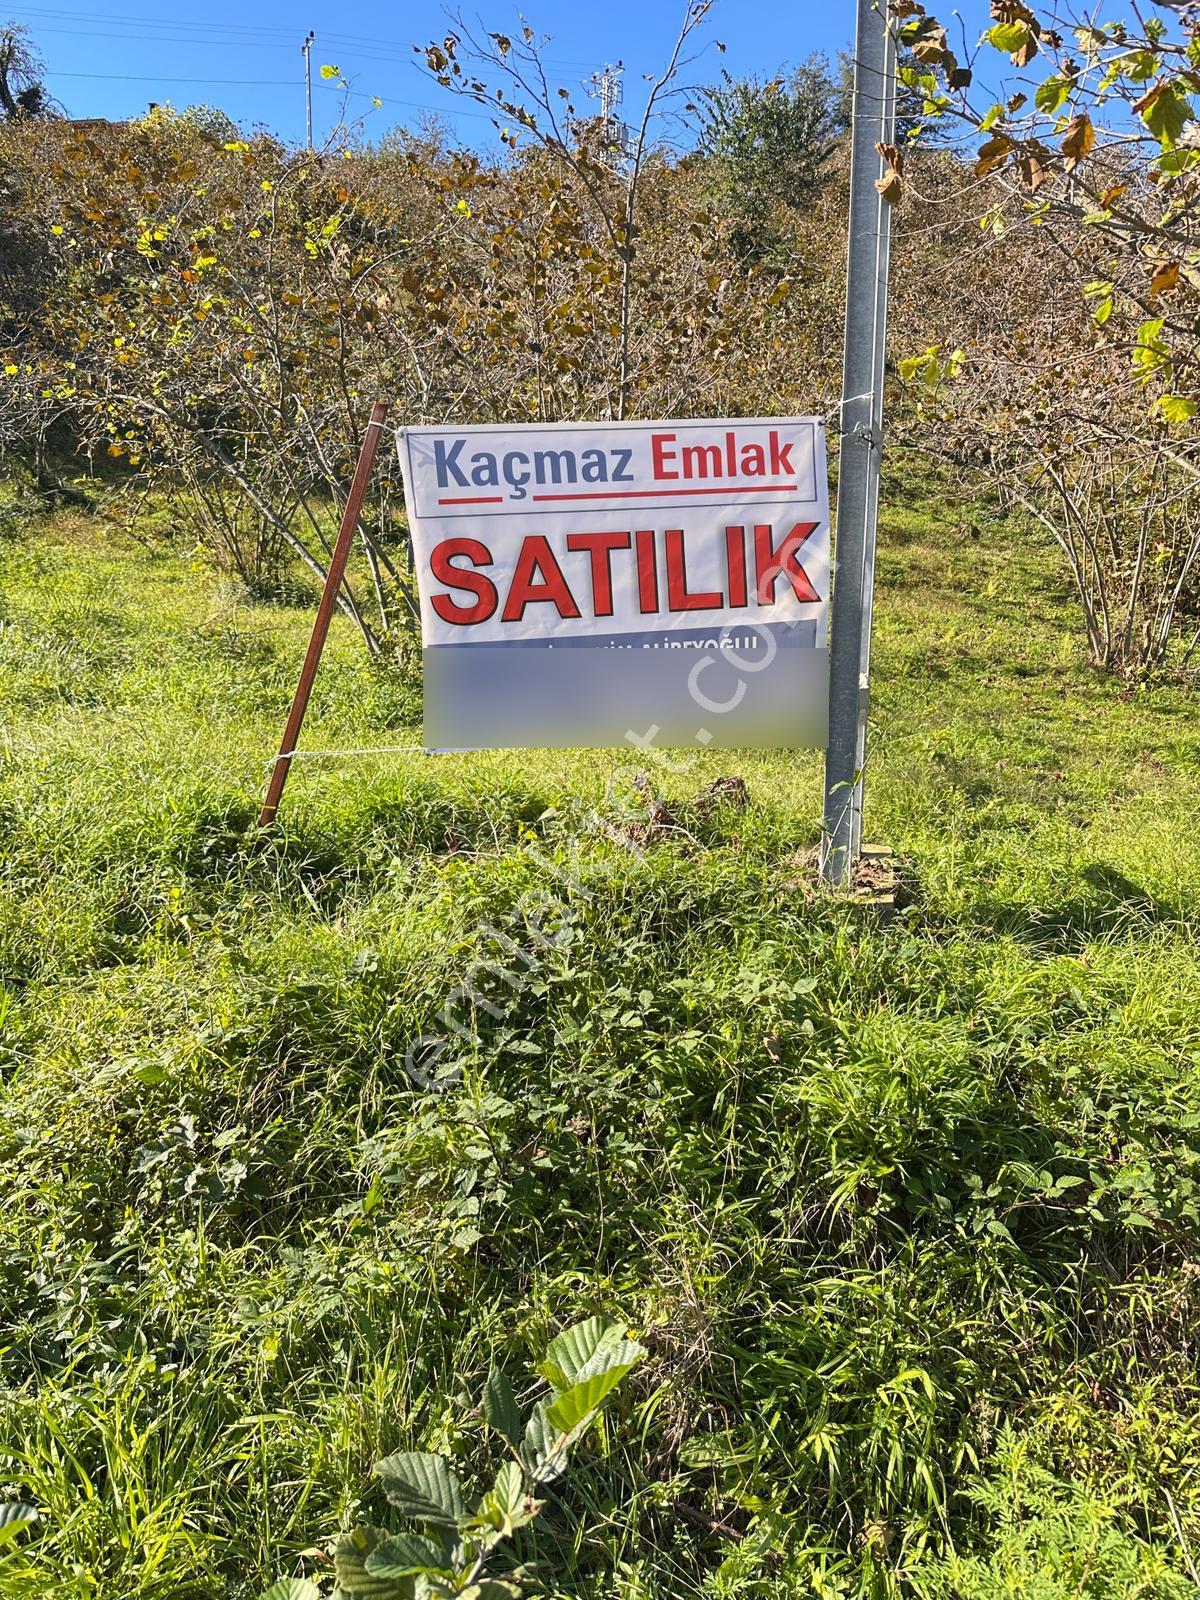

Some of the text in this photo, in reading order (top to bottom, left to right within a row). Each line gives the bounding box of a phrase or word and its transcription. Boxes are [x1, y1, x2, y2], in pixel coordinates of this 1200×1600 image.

[433, 430, 797, 500] Kaçmaz Emlak
[429, 521, 822, 626] SATILIK
